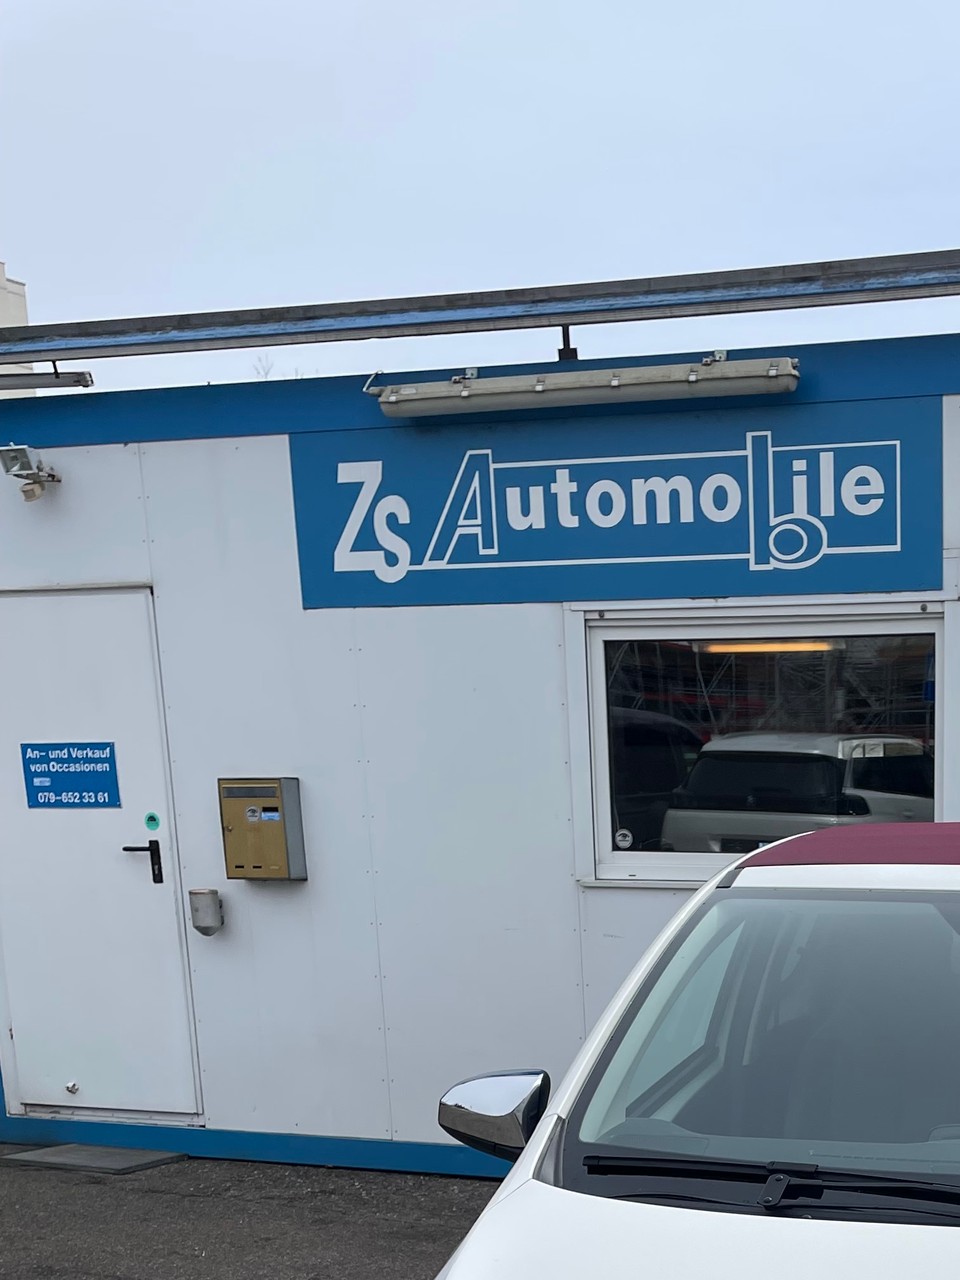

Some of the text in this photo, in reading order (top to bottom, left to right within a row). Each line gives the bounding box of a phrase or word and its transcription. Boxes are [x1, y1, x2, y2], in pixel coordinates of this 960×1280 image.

[422, 431, 887, 571] Automobile
[26, 747, 110, 759] An- und Verkauf
[30, 761, 109, 772] von Occasionen
[38, 792, 109, 803] 079-652 33 61
